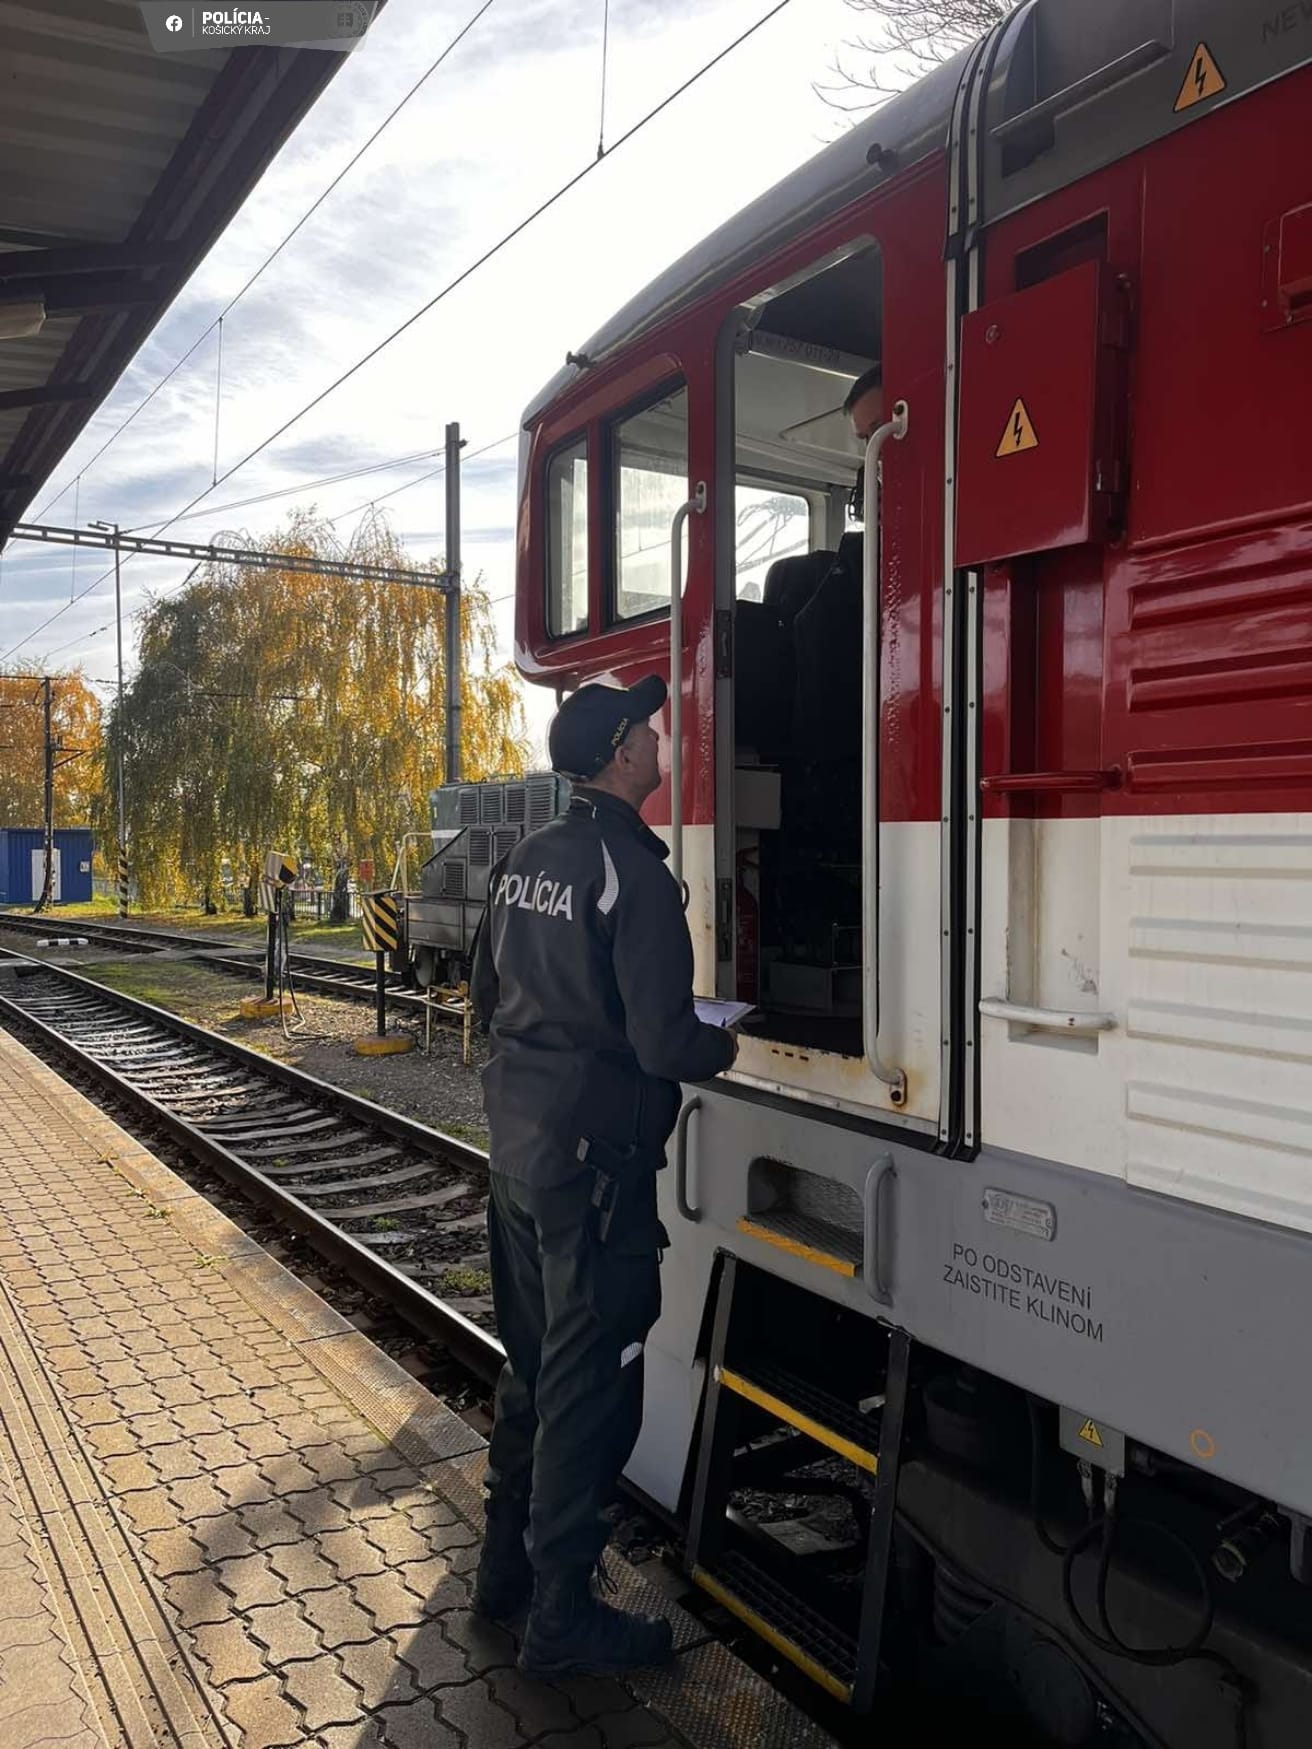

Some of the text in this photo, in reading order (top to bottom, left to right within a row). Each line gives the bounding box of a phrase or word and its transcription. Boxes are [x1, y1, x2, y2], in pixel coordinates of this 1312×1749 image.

[611, 717, 629, 747] POLÍCIA
[494, 870, 574, 922] POLÍCIA
[953, 1243, 977, 1267] PO
[943, 1264, 1103, 1343] ZAISTITE KLINOM
